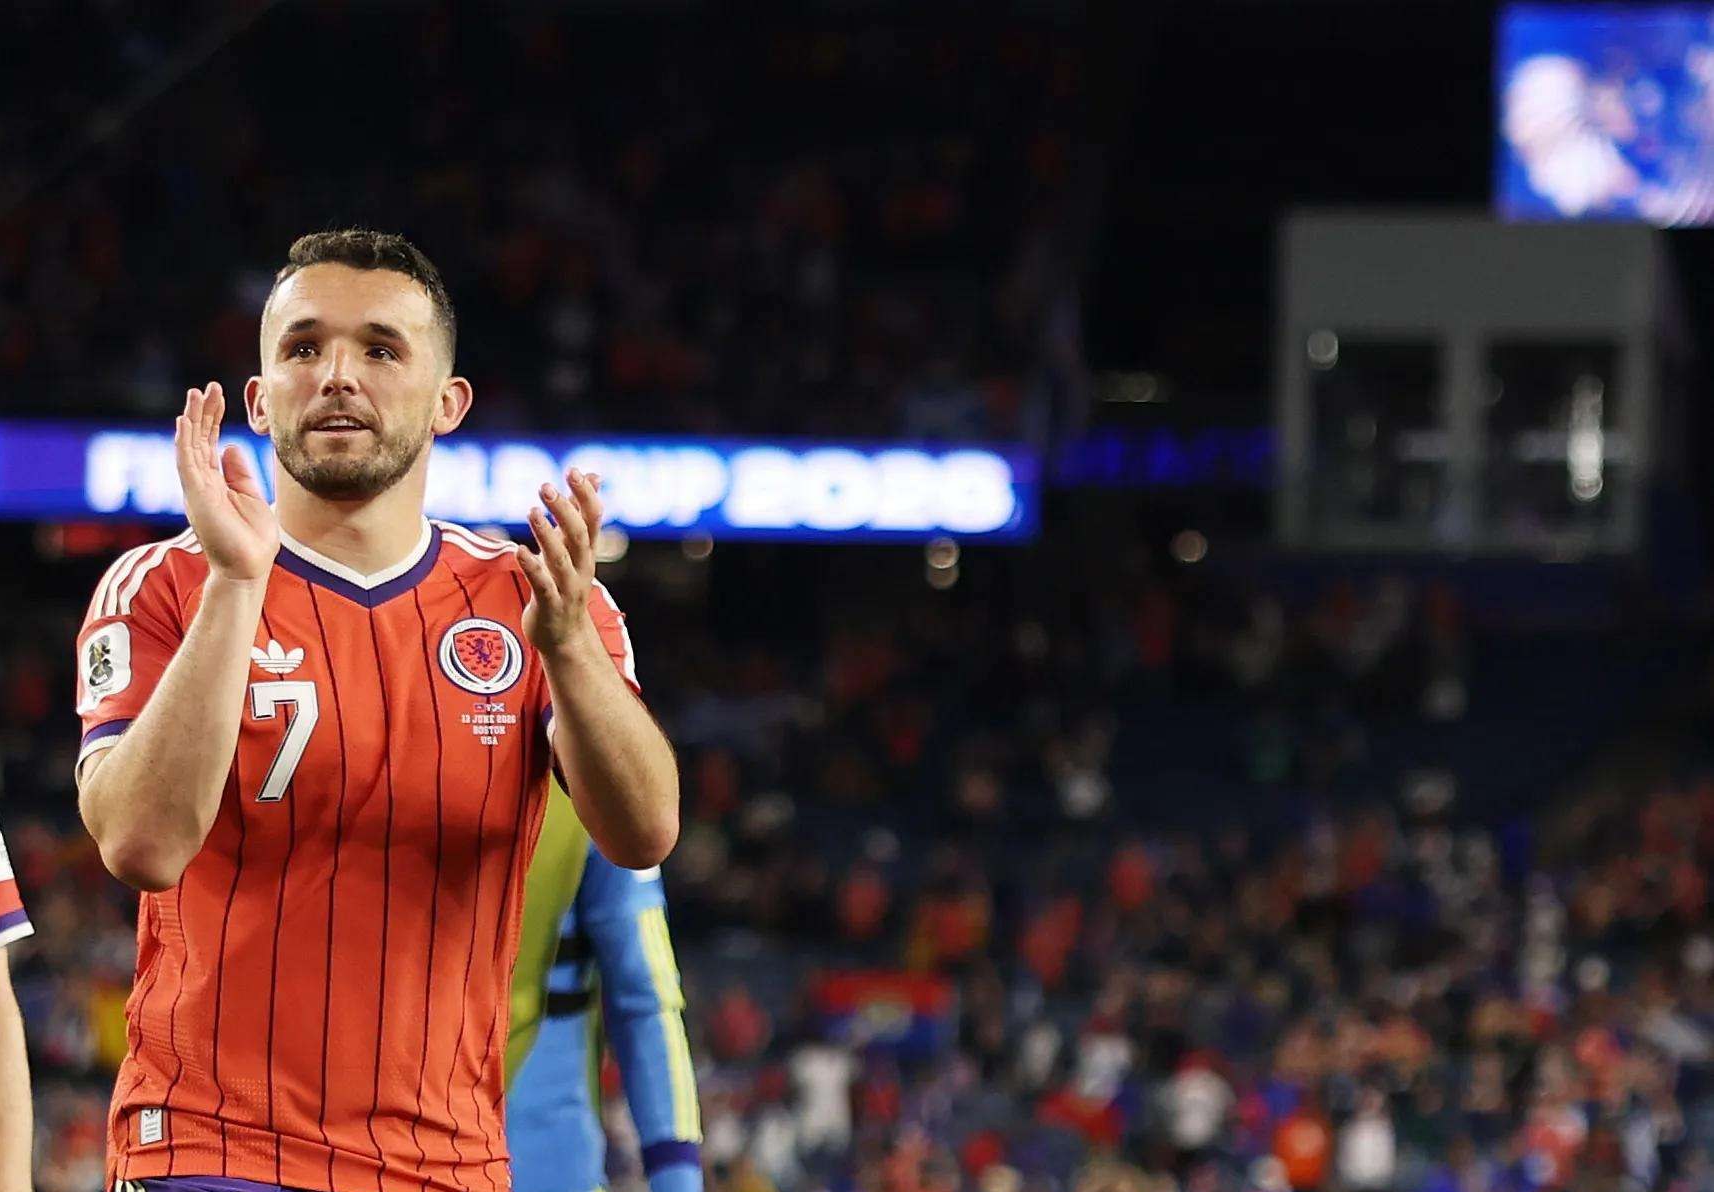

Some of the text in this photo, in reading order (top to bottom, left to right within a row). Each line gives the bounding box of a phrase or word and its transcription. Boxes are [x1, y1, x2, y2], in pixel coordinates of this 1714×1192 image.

[730, 446, 1016, 532] 2026
[250, 681, 319, 802] 7
[480, 736, 499, 746] USA
